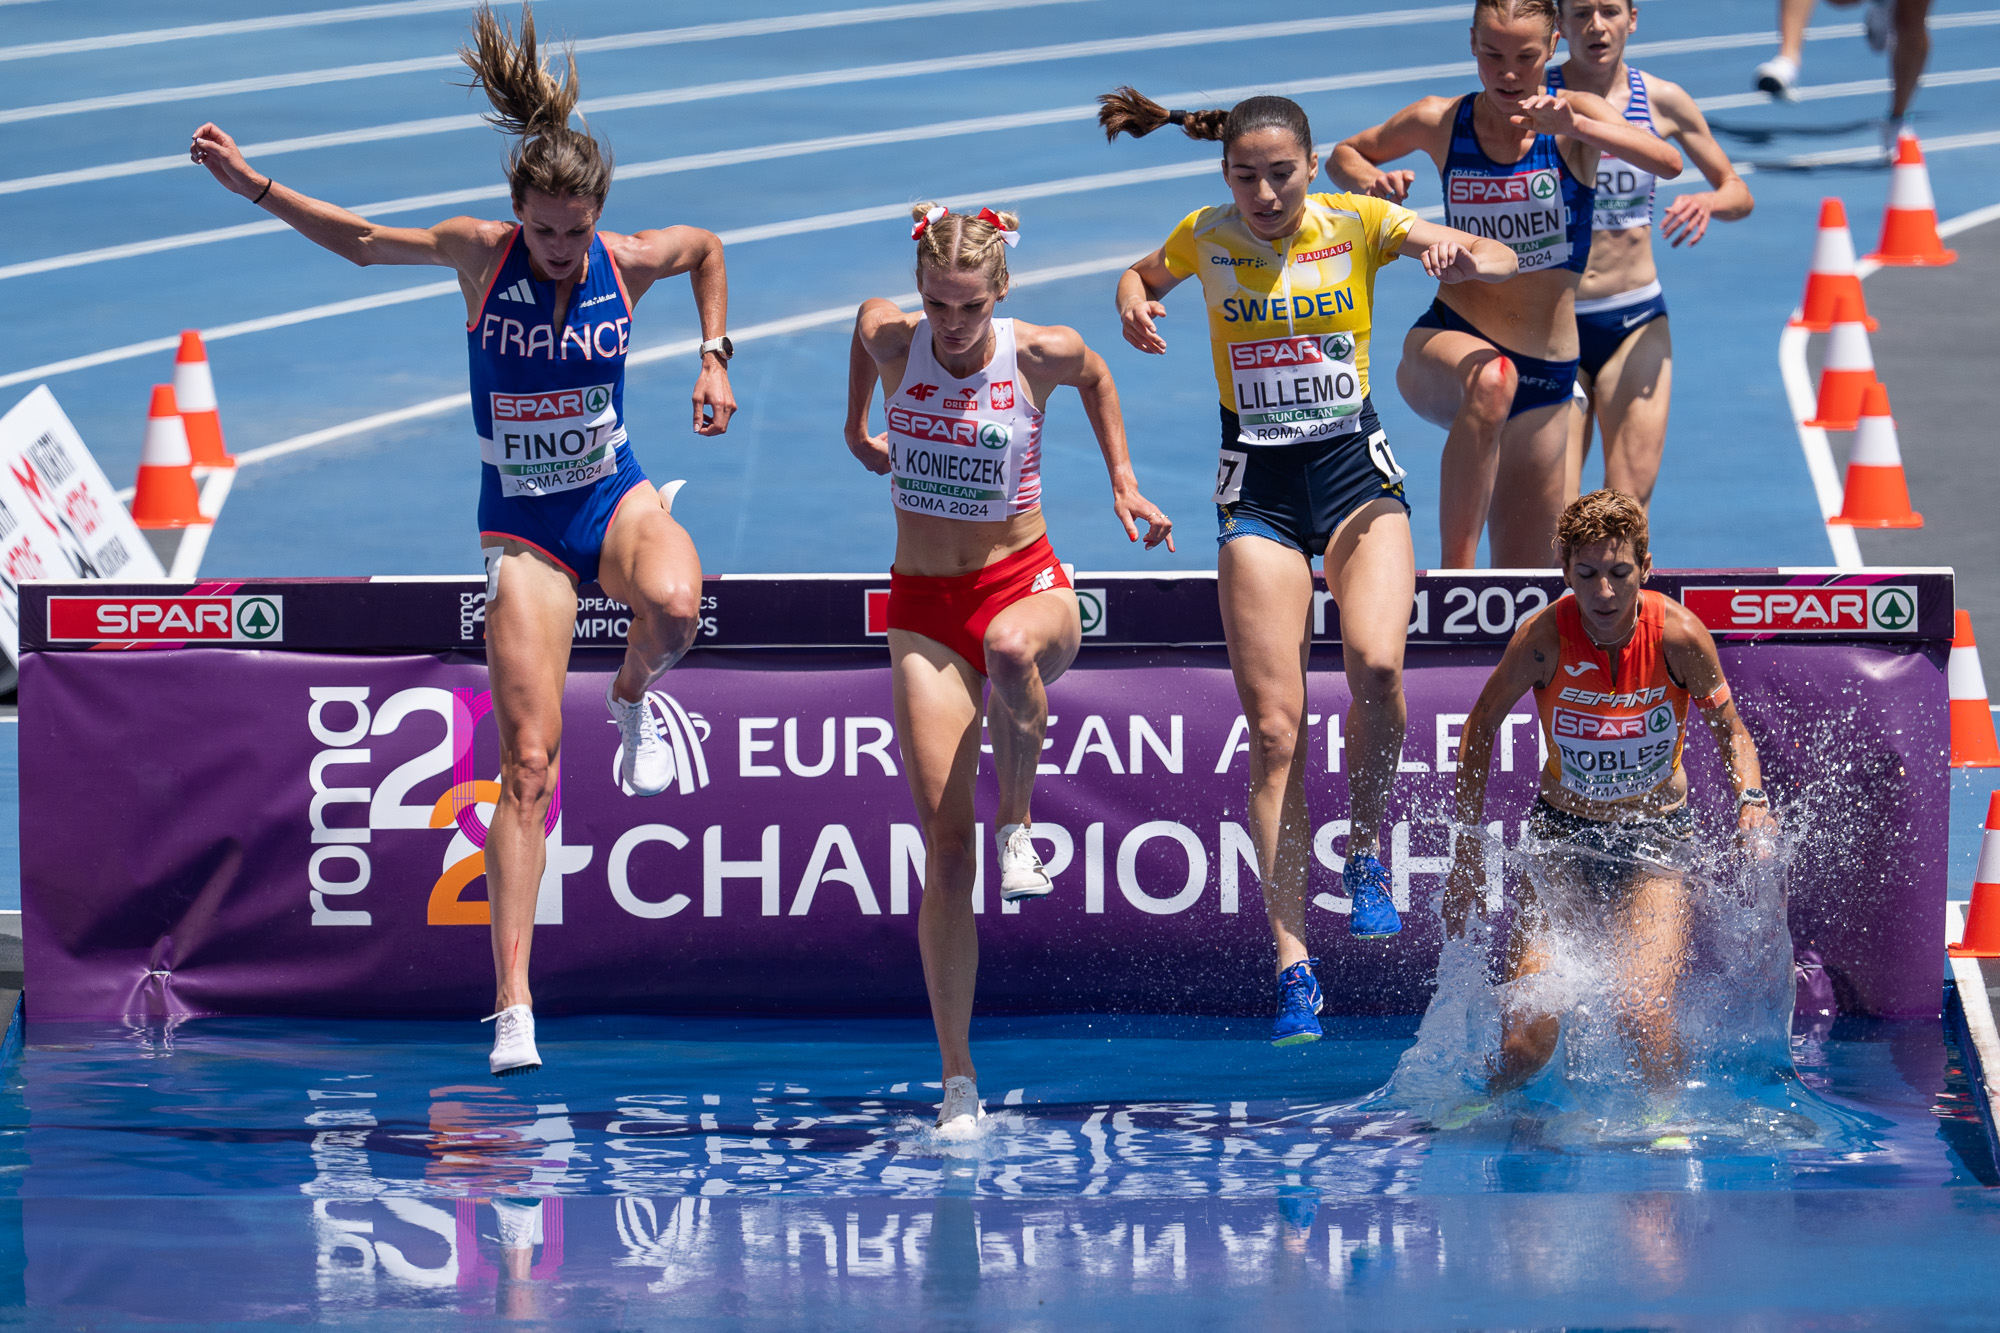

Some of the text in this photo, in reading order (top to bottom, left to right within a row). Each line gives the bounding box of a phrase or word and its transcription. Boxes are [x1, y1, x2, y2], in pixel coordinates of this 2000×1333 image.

[1452, 181, 1527, 201] SPAR
[1597, 170, 1636, 194] RD
[1453, 209, 1560, 240] MONONEN
[1297, 242, 1352, 262] BAUHAUS
[1510, 243, 1539, 253] LEAN
[1518, 250, 1552, 269] 2024
[1211, 256, 1255, 268] CRAFT
[1223, 287, 1354, 322] SWEDEN
[482, 314, 628, 361] FRANCE
[1234, 340, 1321, 366] SPAR
[906, 382, 939, 401] 4F
[1238, 372, 1355, 410] LILLEMO
[495, 396, 581, 418] SPAR
[945, 401, 977, 410] ORLEN
[1268, 411, 1292, 423] RUN
[890, 411, 975, 443] SPAR
[1257, 420, 1345, 441] ROMA 2024
[504, 425, 605, 460] FINOT
[516, 464, 602, 491] ROMA 2024
[526, 464, 552, 474] RUN
[906, 448, 1006, 485] KONIECZEK
[911, 481, 937, 493] RUN
[898, 493, 989, 517] ROMA 2024
[96, 604, 228, 633] SPAR
[460, 592, 473, 640] roma
[1443, 586, 1576, 635] 202
[1731, 594, 1864, 624] SPAR
[1557, 714, 1644, 737] SPAR
[1558, 739, 1670, 772] ROBLES
[1575, 780, 1621, 797] ROMA
[308, 686, 372, 926] roma
